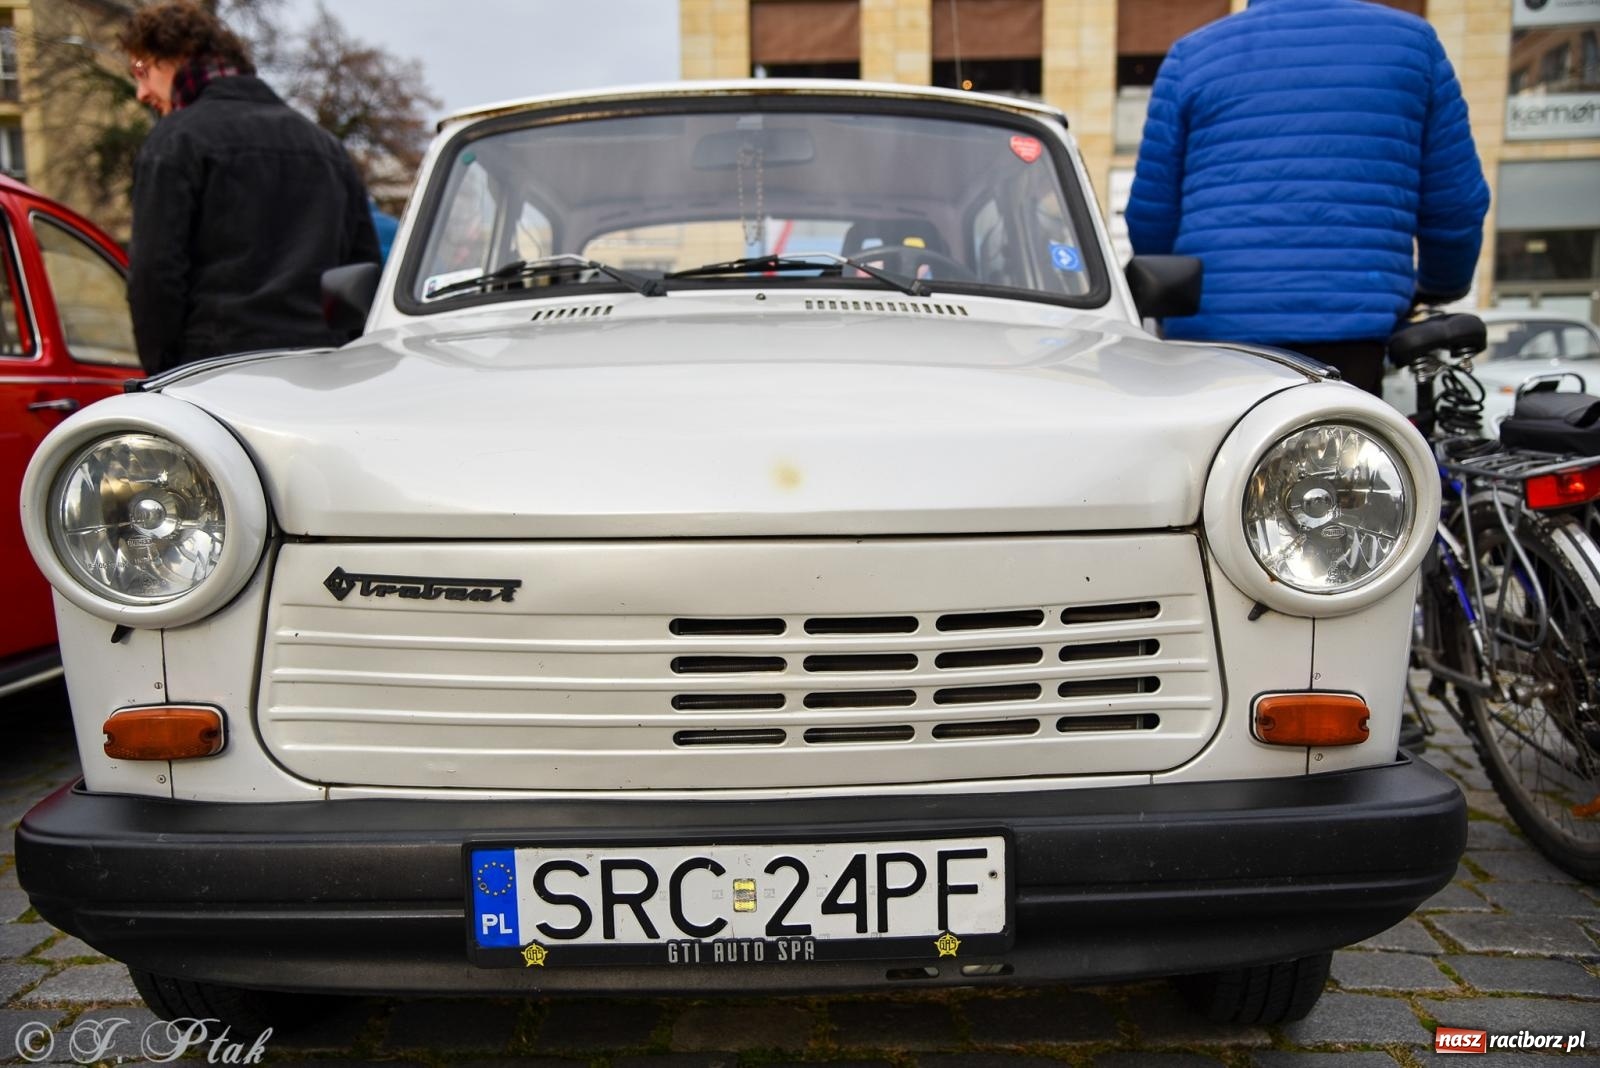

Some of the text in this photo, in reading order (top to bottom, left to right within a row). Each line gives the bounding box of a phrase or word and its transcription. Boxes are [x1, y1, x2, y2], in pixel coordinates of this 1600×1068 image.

[345, 573, 522, 602] Trabant
[533, 848, 988, 940] SRC 24PF
[482, 913, 512, 935] PL
[668, 940, 815, 963] GTI AUTO SPA
